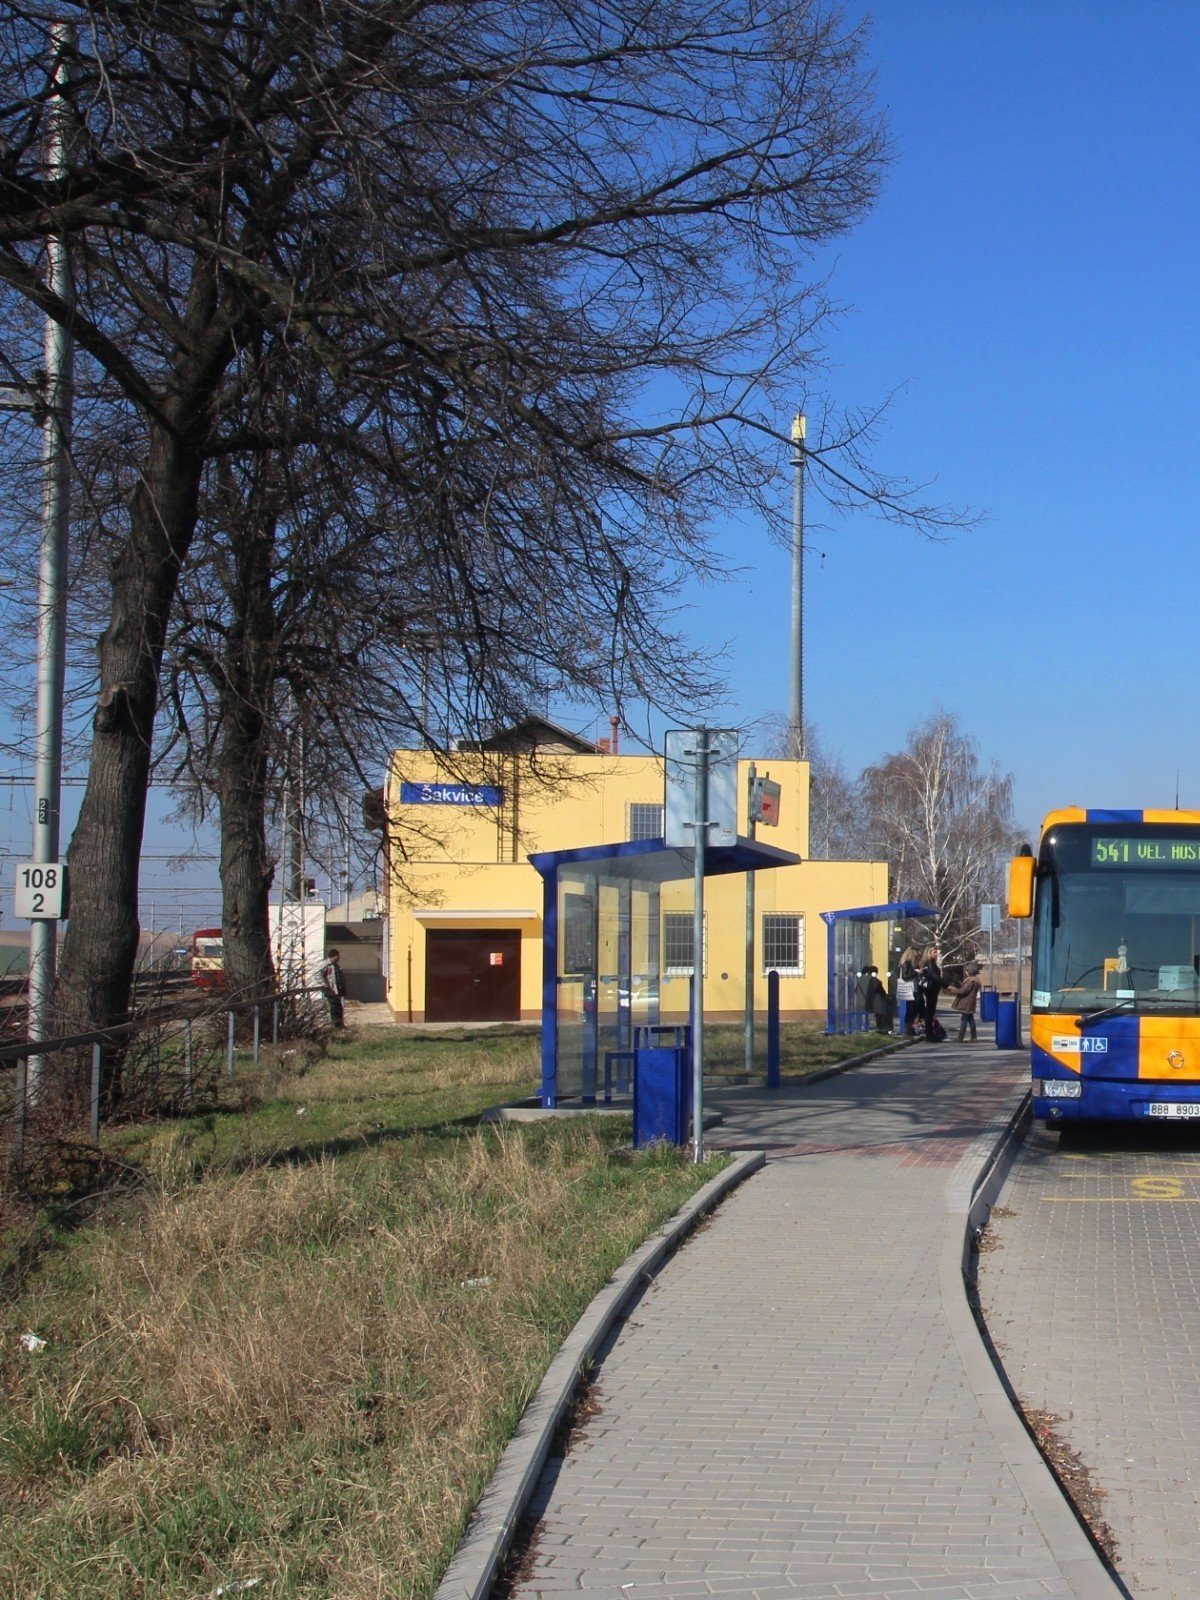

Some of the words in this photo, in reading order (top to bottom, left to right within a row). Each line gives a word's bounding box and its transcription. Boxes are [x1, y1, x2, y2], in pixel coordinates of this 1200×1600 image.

[421, 784, 484, 803] Šakvice
[39, 799, 46, 810] 2
[39, 811, 46, 822] 2
[1096, 840, 1129, 862] 541
[1138, 842, 1166, 860] VEL.
[22, 868, 57, 889] 108
[32, 893, 44, 912] 2
[1176, 1105, 1200, 1115] 8903
